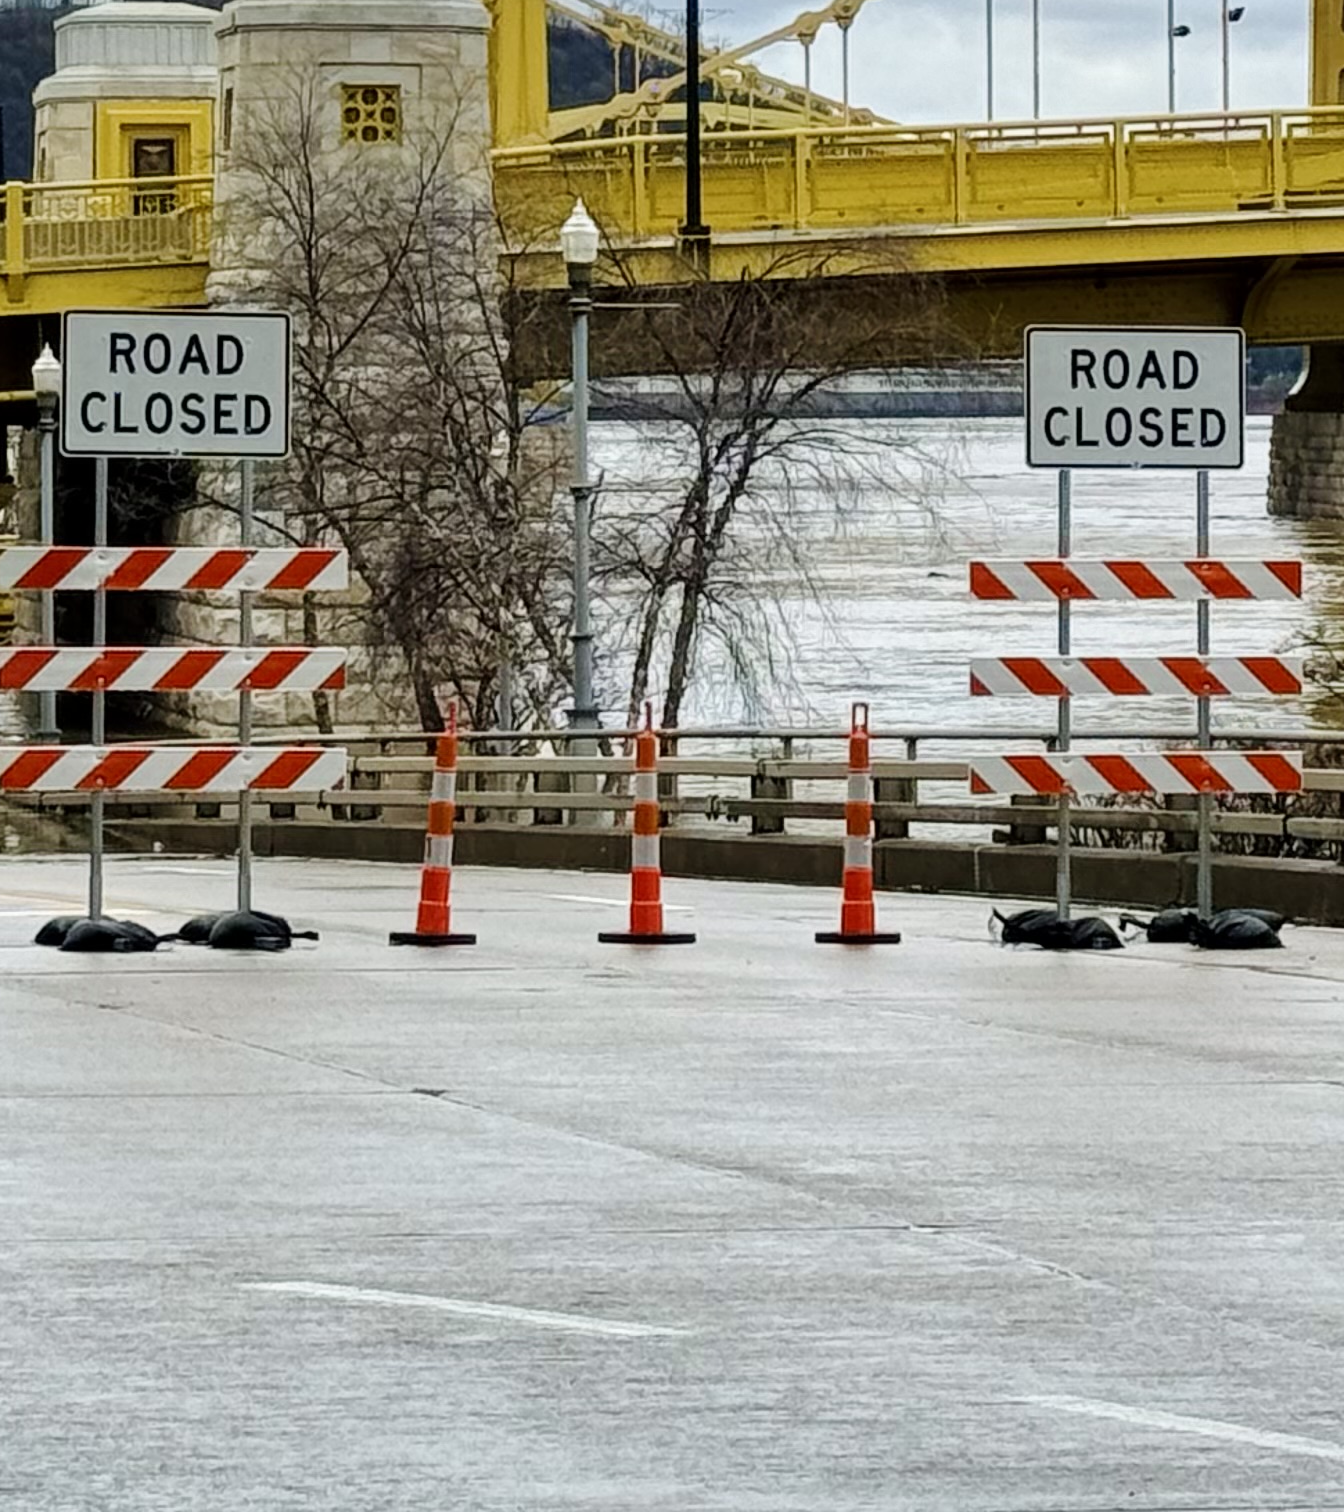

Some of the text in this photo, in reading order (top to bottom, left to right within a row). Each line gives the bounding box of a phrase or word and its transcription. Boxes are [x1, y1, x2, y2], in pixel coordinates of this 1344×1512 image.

[109, 332, 245, 376] ROAD
[1070, 349, 1200, 390] ROAD
[80, 391, 272, 436] CLOSED
[1044, 406, 1227, 448] CLOSED
